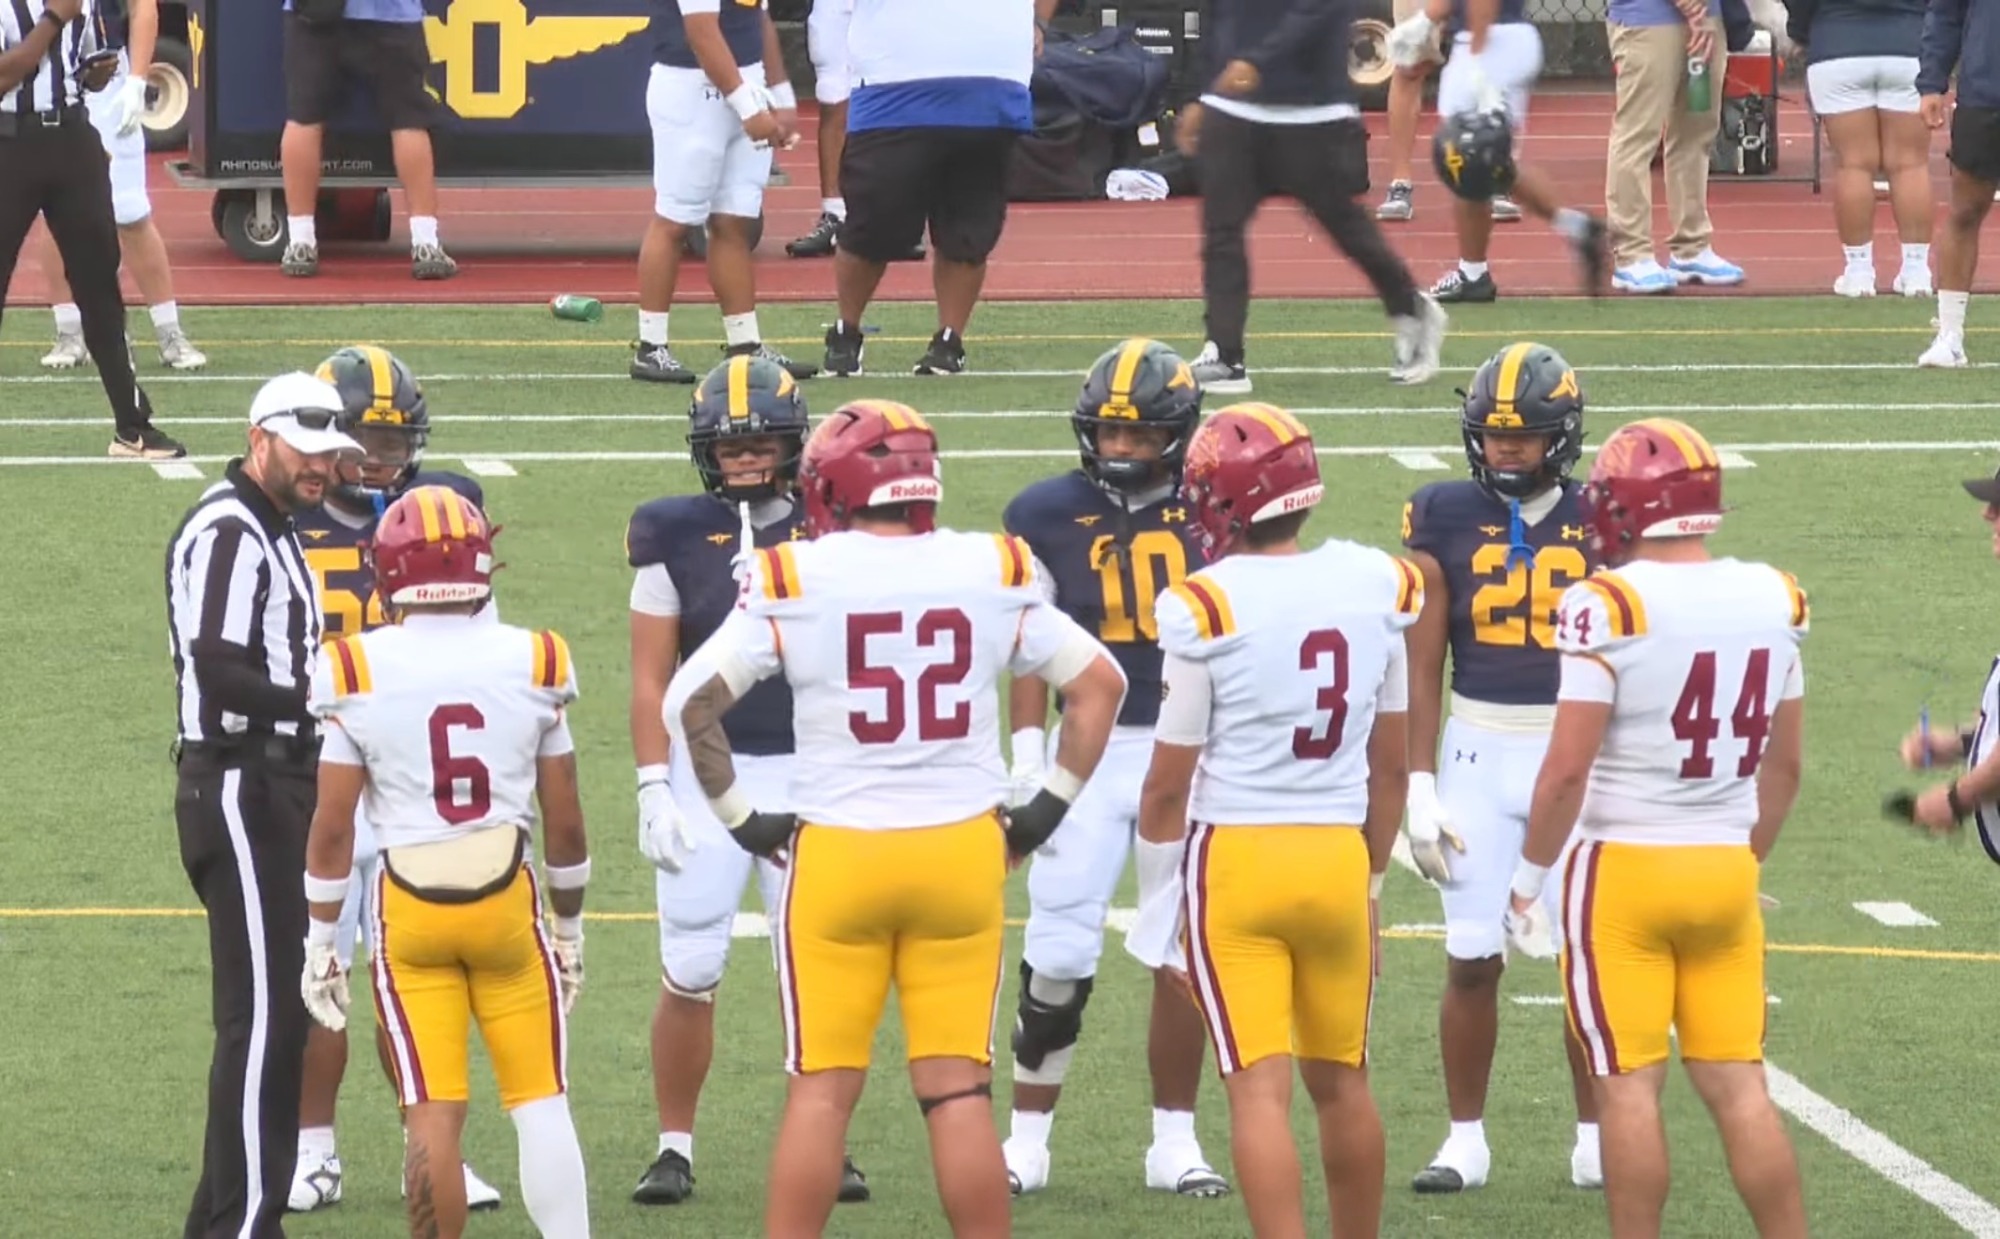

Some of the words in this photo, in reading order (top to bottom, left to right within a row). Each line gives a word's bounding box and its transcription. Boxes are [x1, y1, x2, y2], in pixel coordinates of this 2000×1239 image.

[303, 546, 398, 645] 5
[1090, 529, 1187, 642] 10
[1471, 543, 1587, 649] 26
[846, 607, 973, 744] 52
[1291, 627, 1349, 760] 3
[1671, 648, 1770, 779] 44
[428, 703, 491, 825] 6
